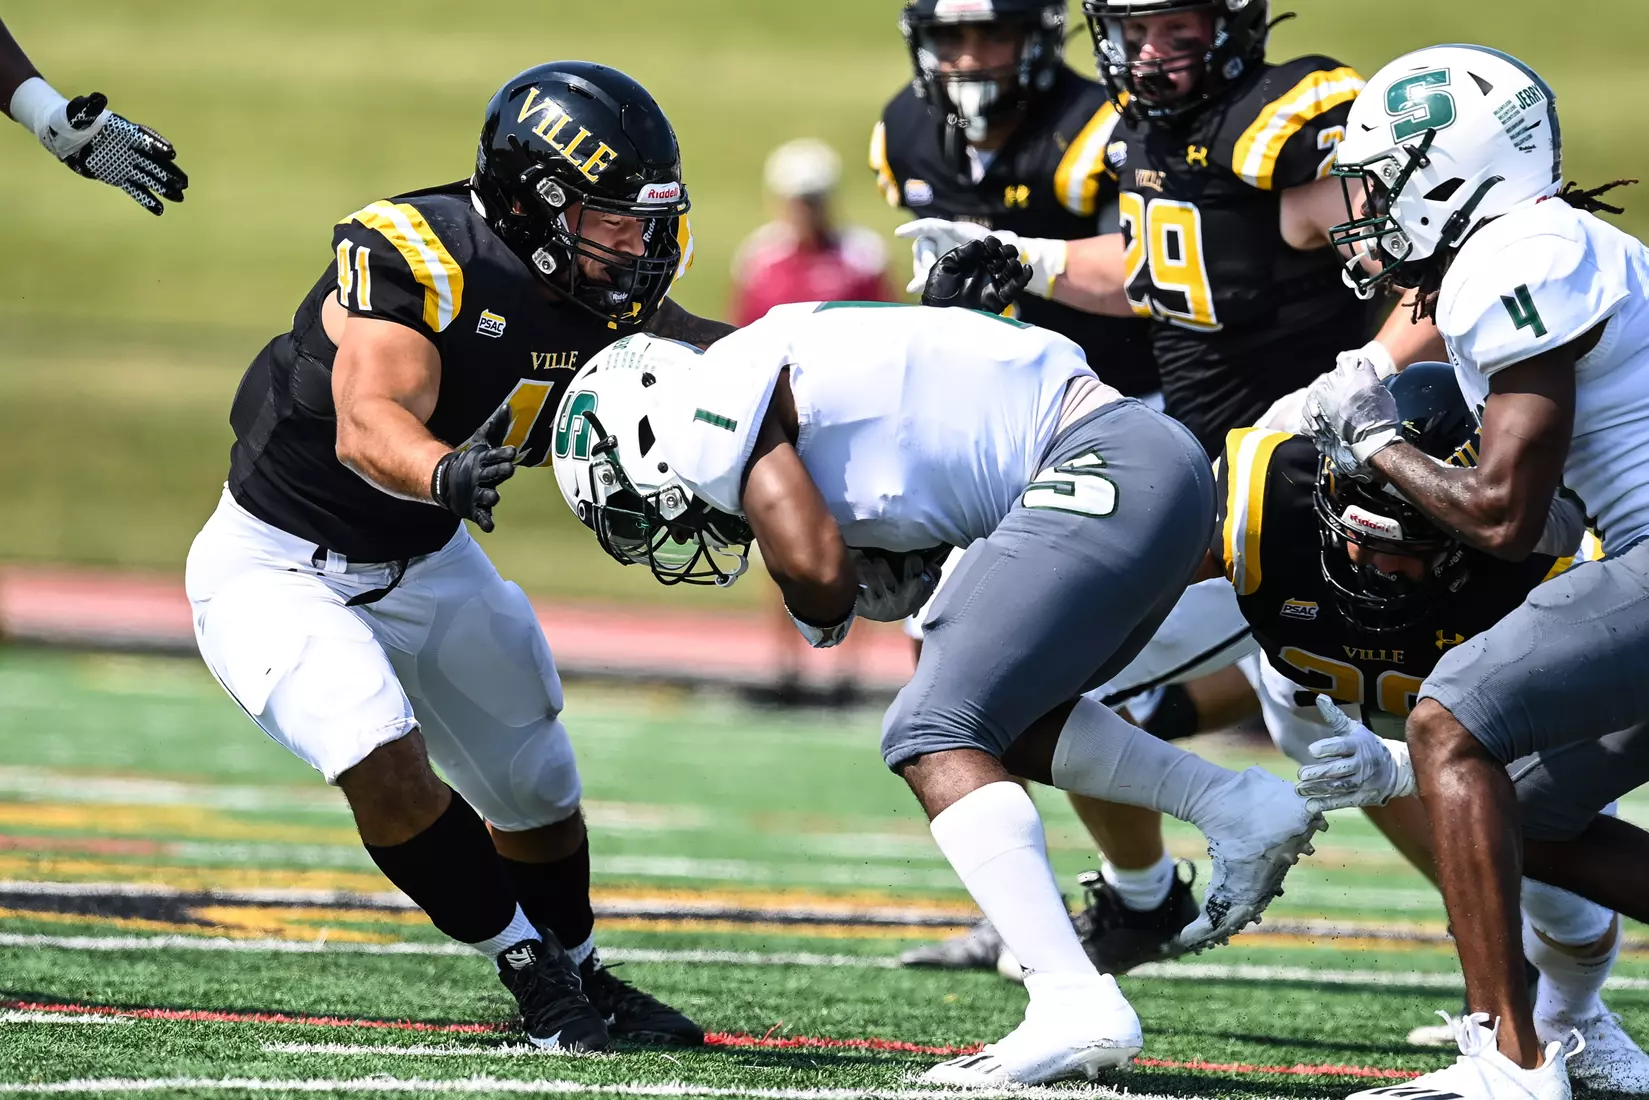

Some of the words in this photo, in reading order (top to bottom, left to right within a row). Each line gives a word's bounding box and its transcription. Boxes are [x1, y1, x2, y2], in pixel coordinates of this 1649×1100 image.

[1384, 67, 1457, 145] S
[1515, 83, 1545, 110] JERRY
[517, 88, 618, 184] VILLE
[336, 237, 373, 311] 41
[1118, 191, 1224, 332] 29
[479, 317, 504, 332] PSAC
[1500, 283, 1548, 338] 4
[530, 351, 579, 371] VILLE
[553, 389, 598, 461] S
[1283, 604, 1316, 616] PSAC
[1342, 645, 1405, 664] VILLE
